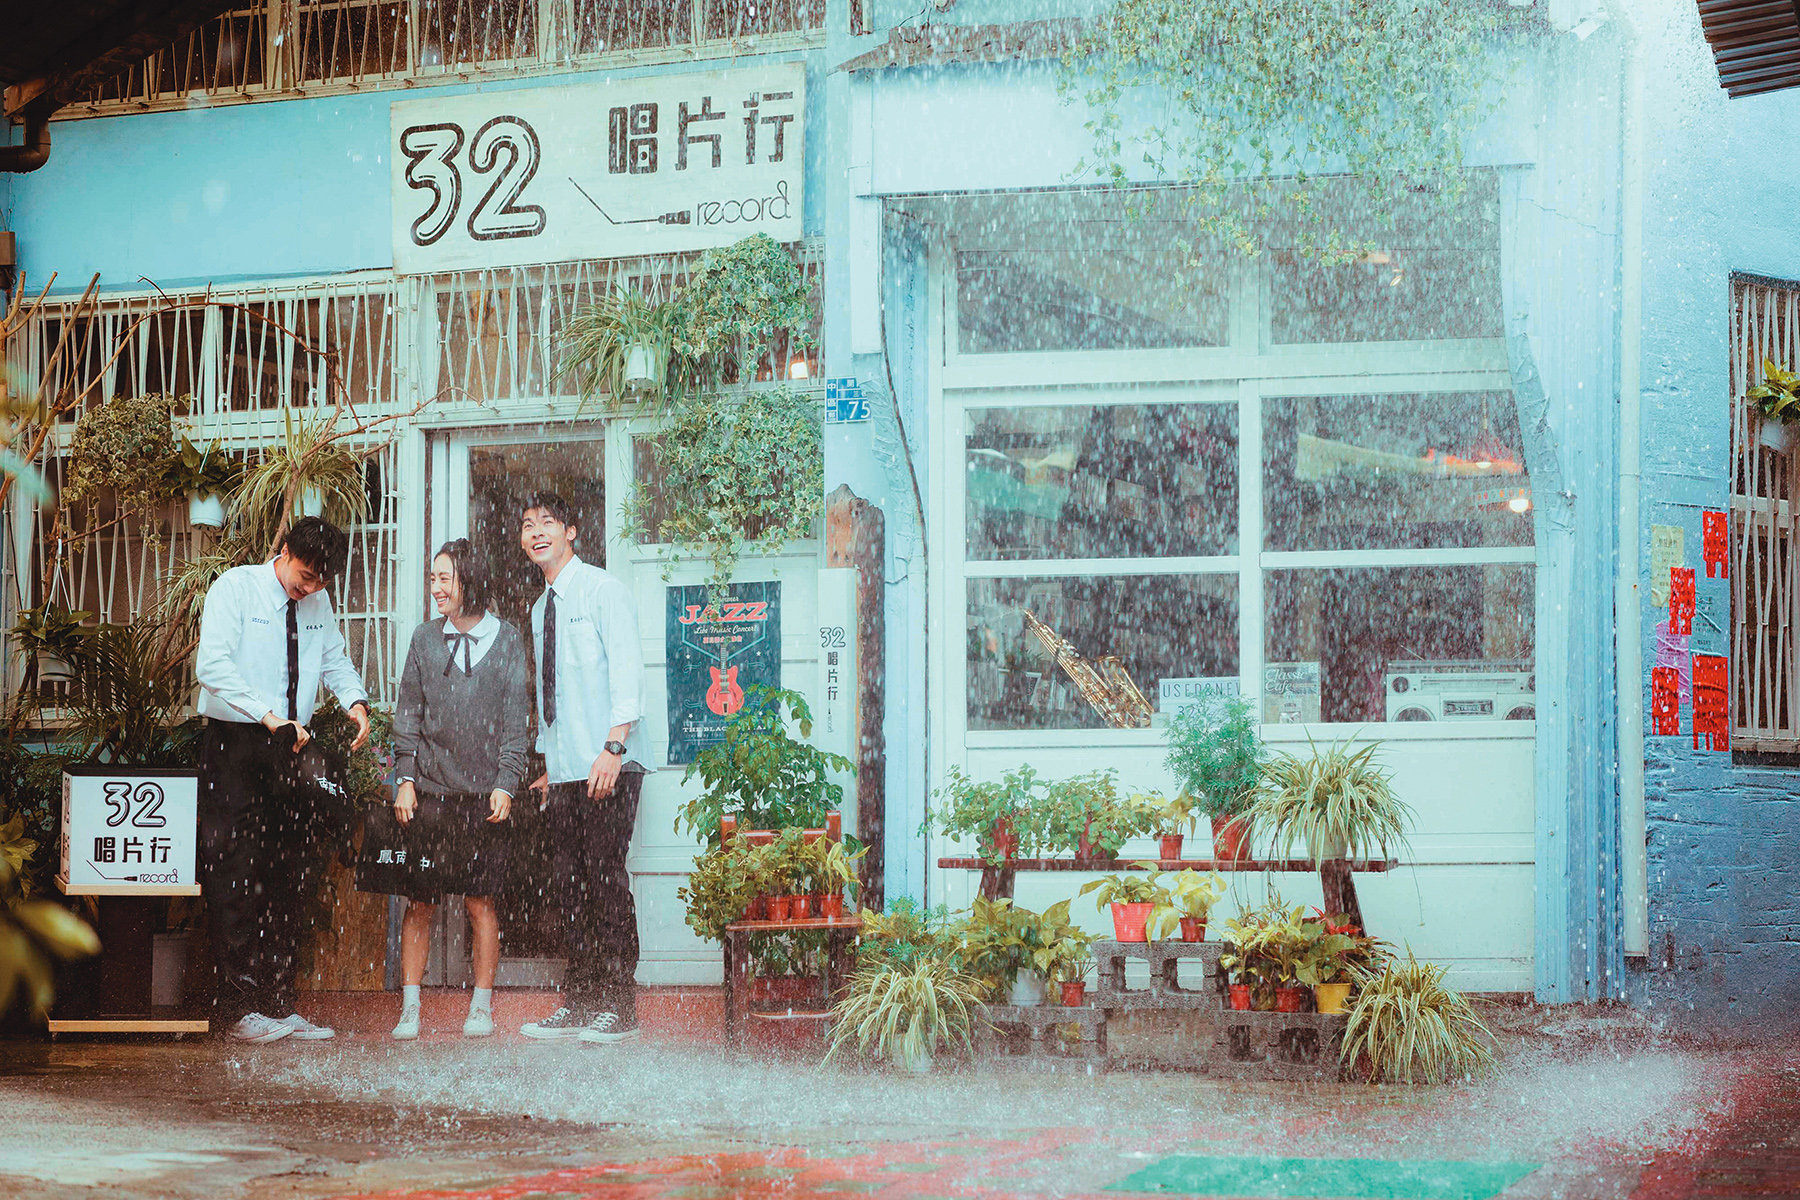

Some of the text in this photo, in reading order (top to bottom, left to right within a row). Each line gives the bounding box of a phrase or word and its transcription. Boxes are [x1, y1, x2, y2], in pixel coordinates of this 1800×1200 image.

[608, 91, 794, 174] 唱片行
[399, 115, 546, 247] 32
[696, 180, 791, 226] record
[849, 401, 871, 419] 75
[679, 602, 768, 624] JAZZ
[732, 625, 757, 634] Concert
[820, 627, 846, 648] 32
[828, 652, 838, 700] 唱片行
[1265, 669, 1306, 681] Classic
[103, 781, 166, 828] 32
[94, 836, 171, 863] 唱片行
[139, 868, 179, 883] record
